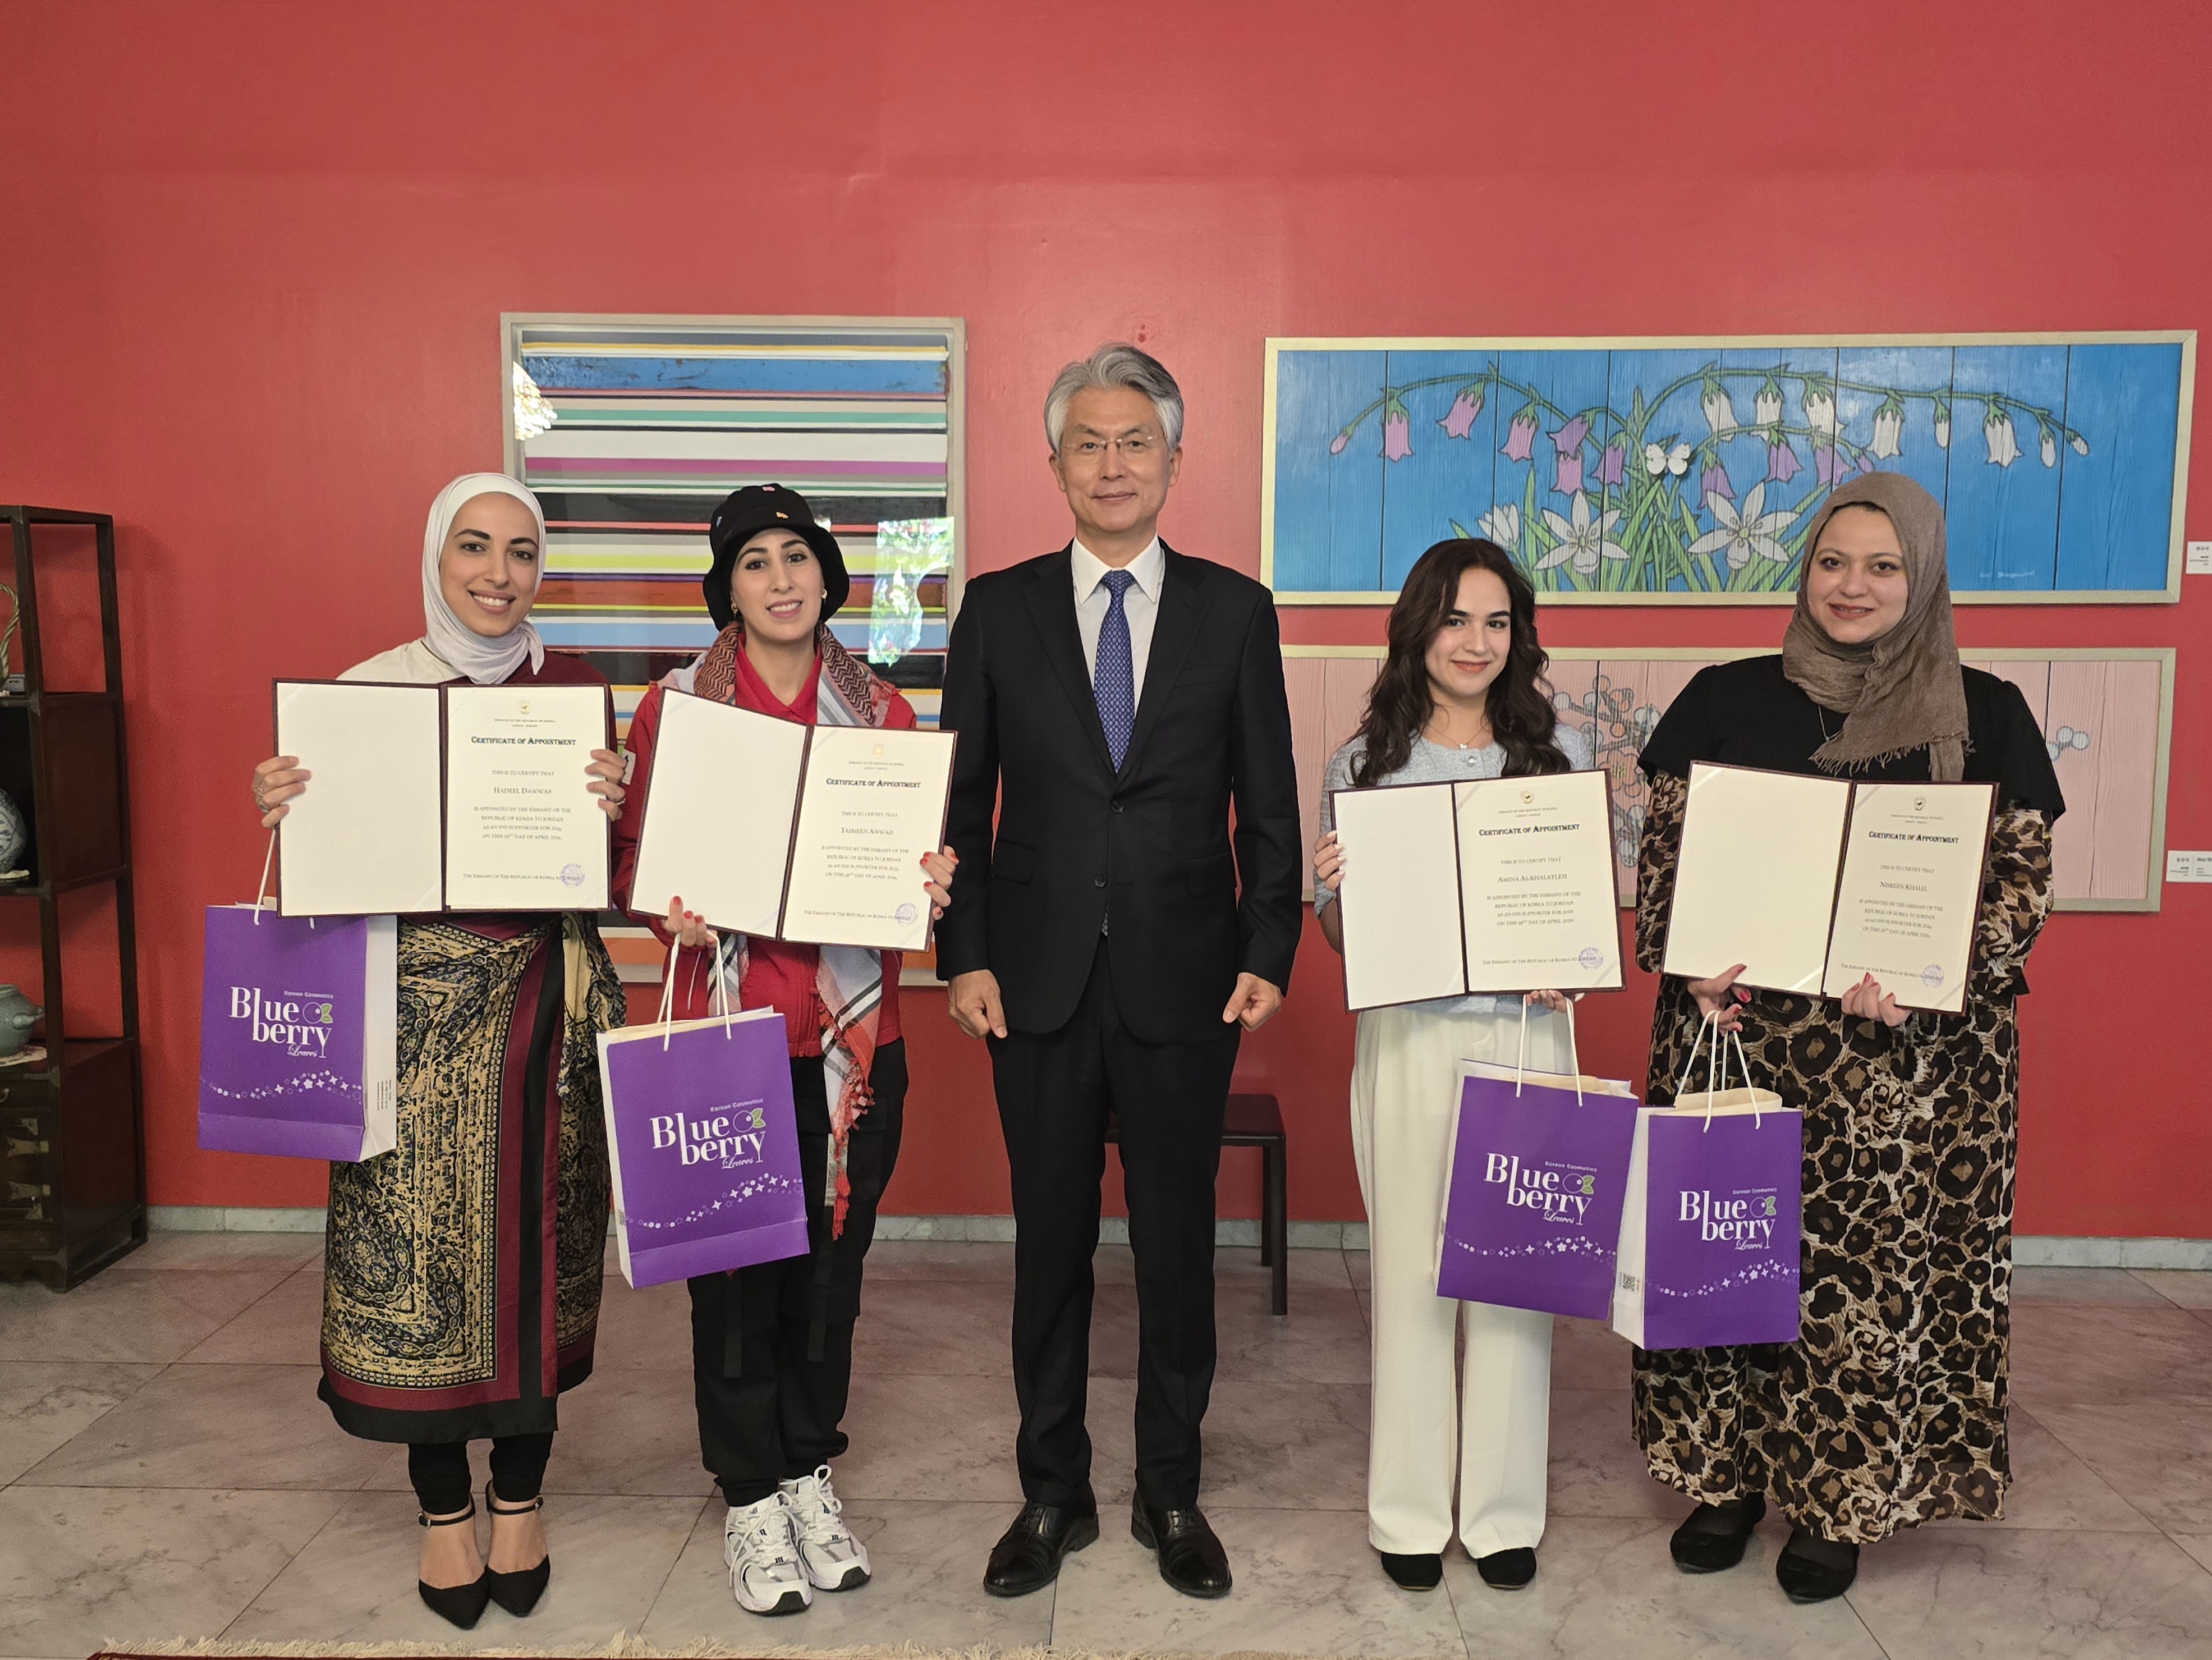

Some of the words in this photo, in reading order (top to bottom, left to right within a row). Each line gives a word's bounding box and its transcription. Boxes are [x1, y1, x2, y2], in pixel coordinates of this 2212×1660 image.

[229, 986, 299, 1022] Blue
[253, 1022, 333, 1058] berry
[649, 1112, 730, 1149] Blue
[682, 1130, 766, 1166] berry
[1484, 1153, 1559, 1191] Blue
[1507, 1187, 1593, 1226] berry
[1678, 1190, 1747, 1221] Blue
[1701, 1218, 1776, 1250] berry
